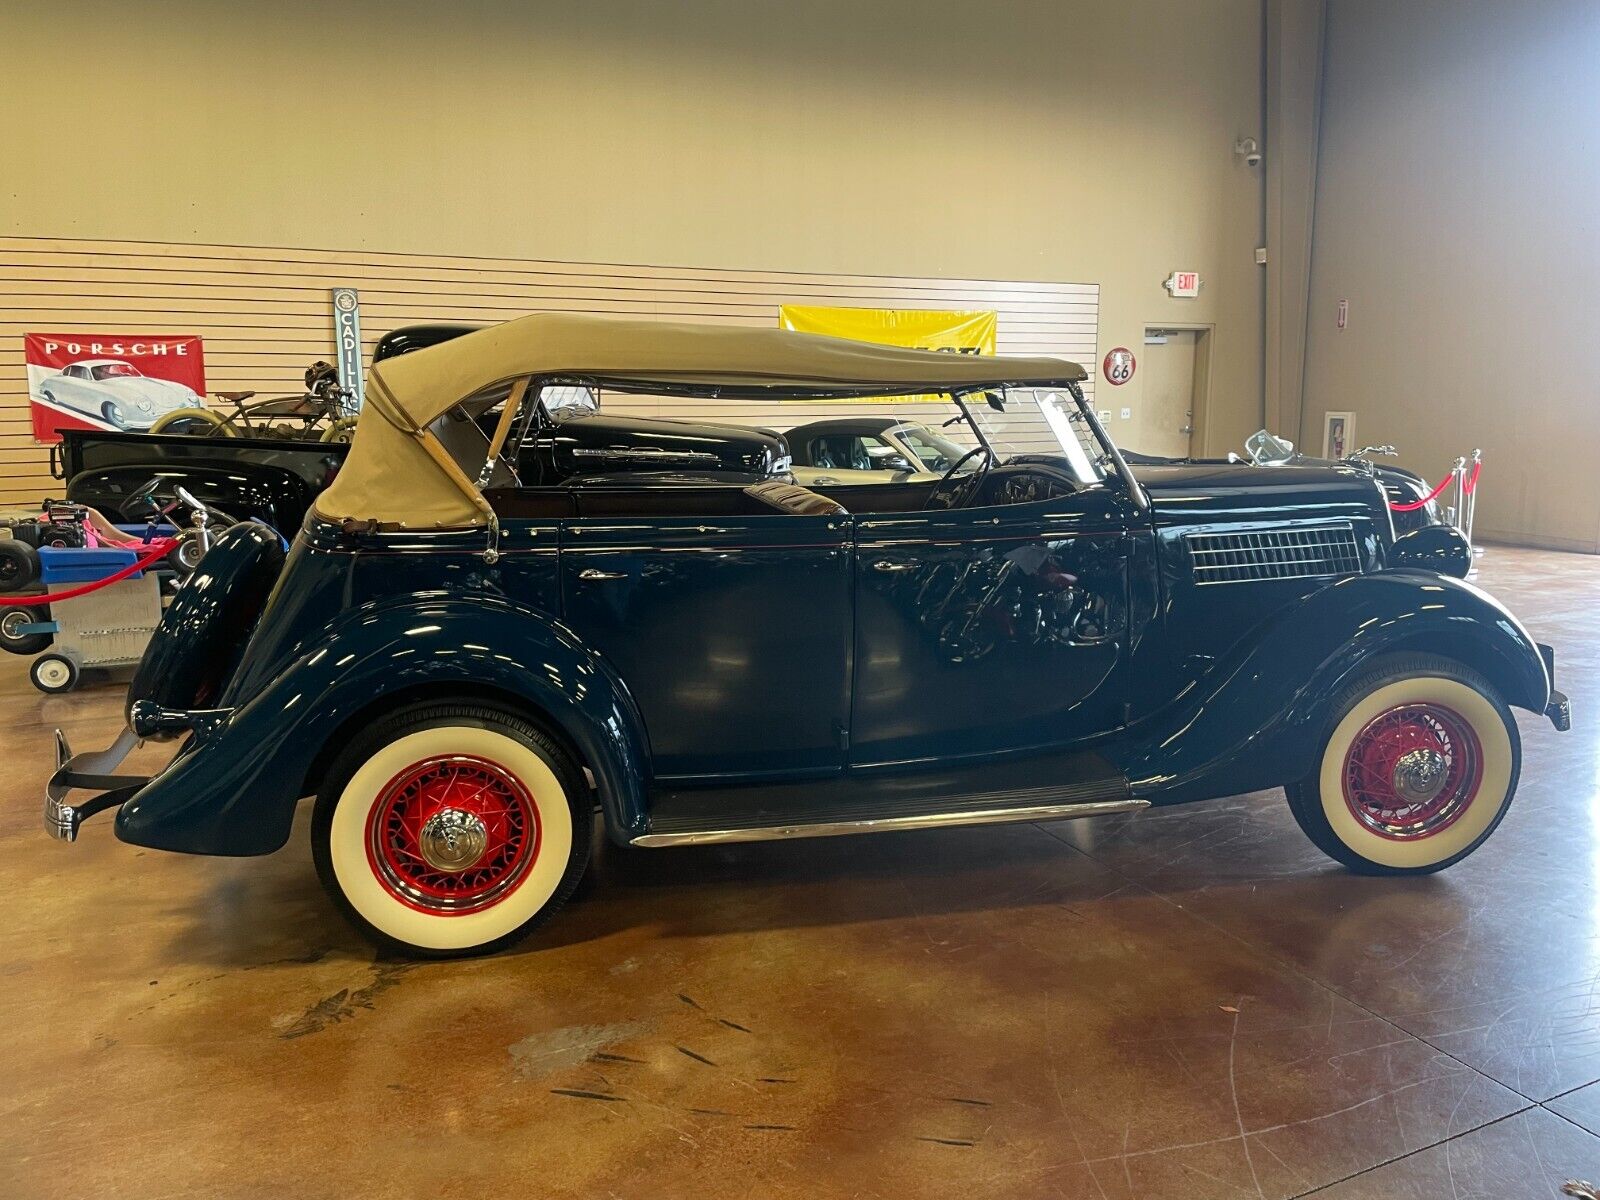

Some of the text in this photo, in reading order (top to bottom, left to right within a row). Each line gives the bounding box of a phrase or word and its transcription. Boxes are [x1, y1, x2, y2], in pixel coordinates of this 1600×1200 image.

[1178, 274, 1196, 289] EXIT
[45, 343, 187, 356] PORSCHE
[1112, 364, 1129, 379] 66
